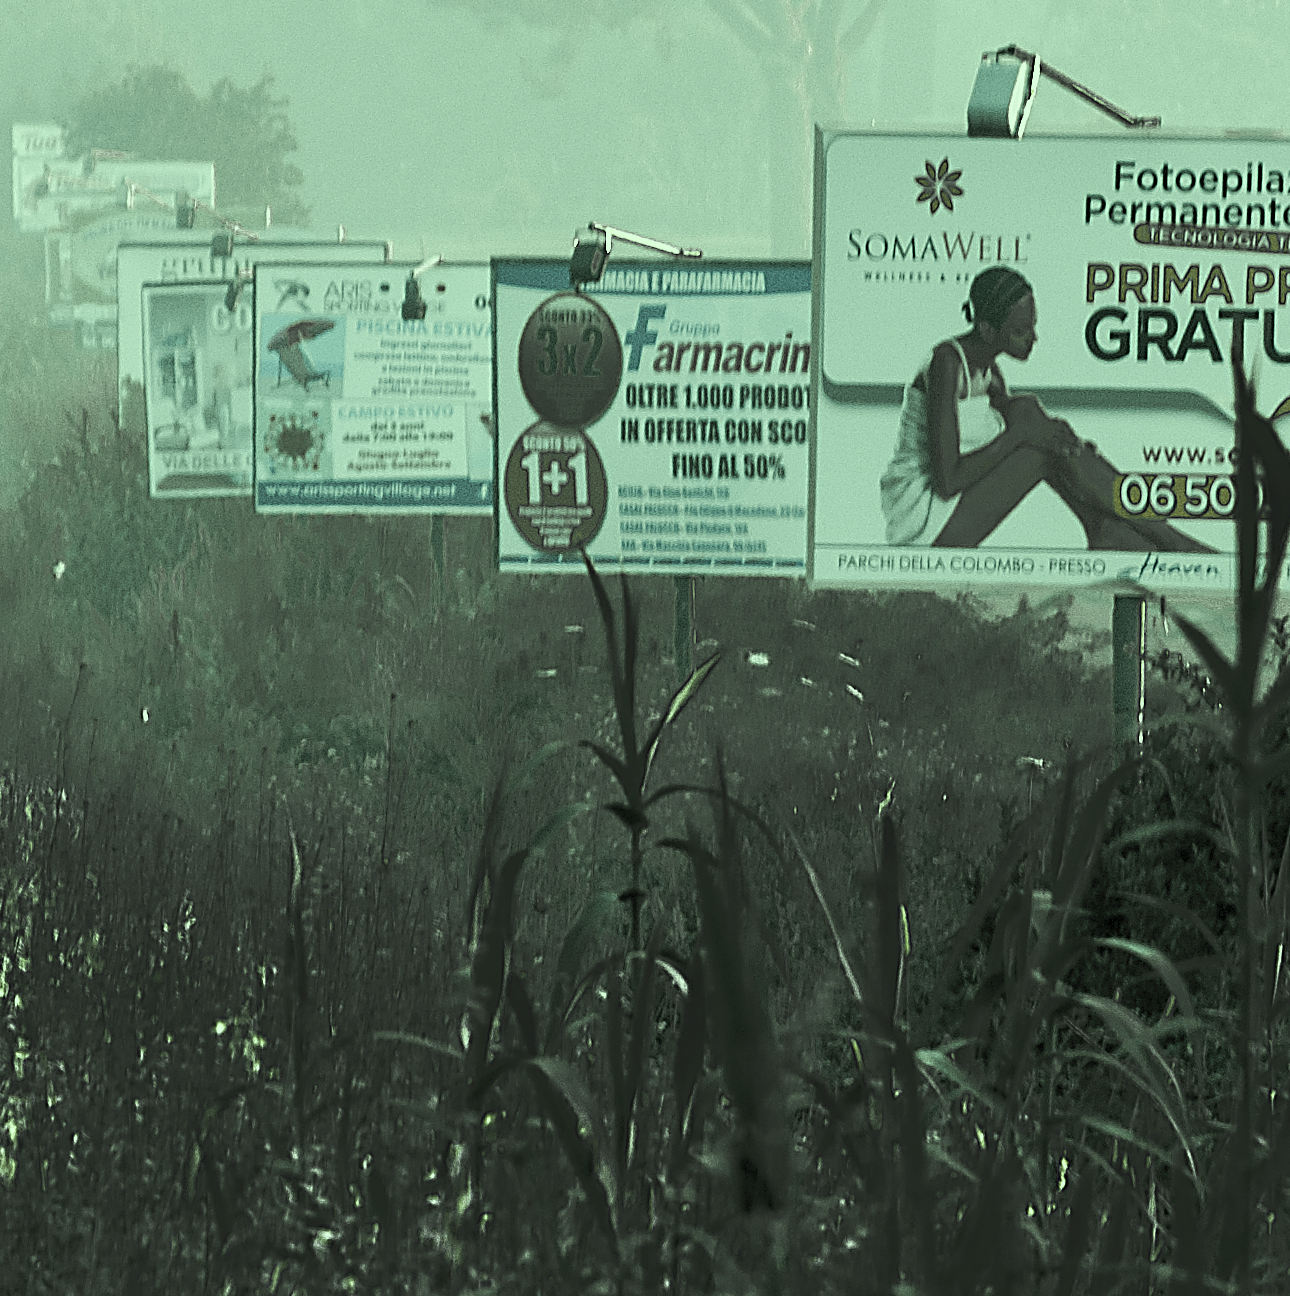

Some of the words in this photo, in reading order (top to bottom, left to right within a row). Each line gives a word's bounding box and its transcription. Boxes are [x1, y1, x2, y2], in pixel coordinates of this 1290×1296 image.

[1149, 225, 1270, 251] TECNOLOGIA
[1085, 262, 1232, 304] PRIMA
[670, 319, 721, 337] Gruppo
[625, 383, 679, 409] OLTRE
[684, 383, 734, 409] 1.000
[620, 417, 639, 444] IN
[644, 417, 720, 444] OFFERTA
[724, 418, 762, 444] CON
[521, 452, 588, 505] 1+1
[671, 453, 713, 480] FINO
[718, 453, 739, 480] AL
[743, 453, 786, 480] 50%
[1119, 474, 1176, 516] 06
[838, 554, 895, 572] PARCHI
[898, 555, 946, 573] DELLA
[949, 556, 1036, 575] COLOMBO
[1049, 557, 1106, 577] PRESSO
